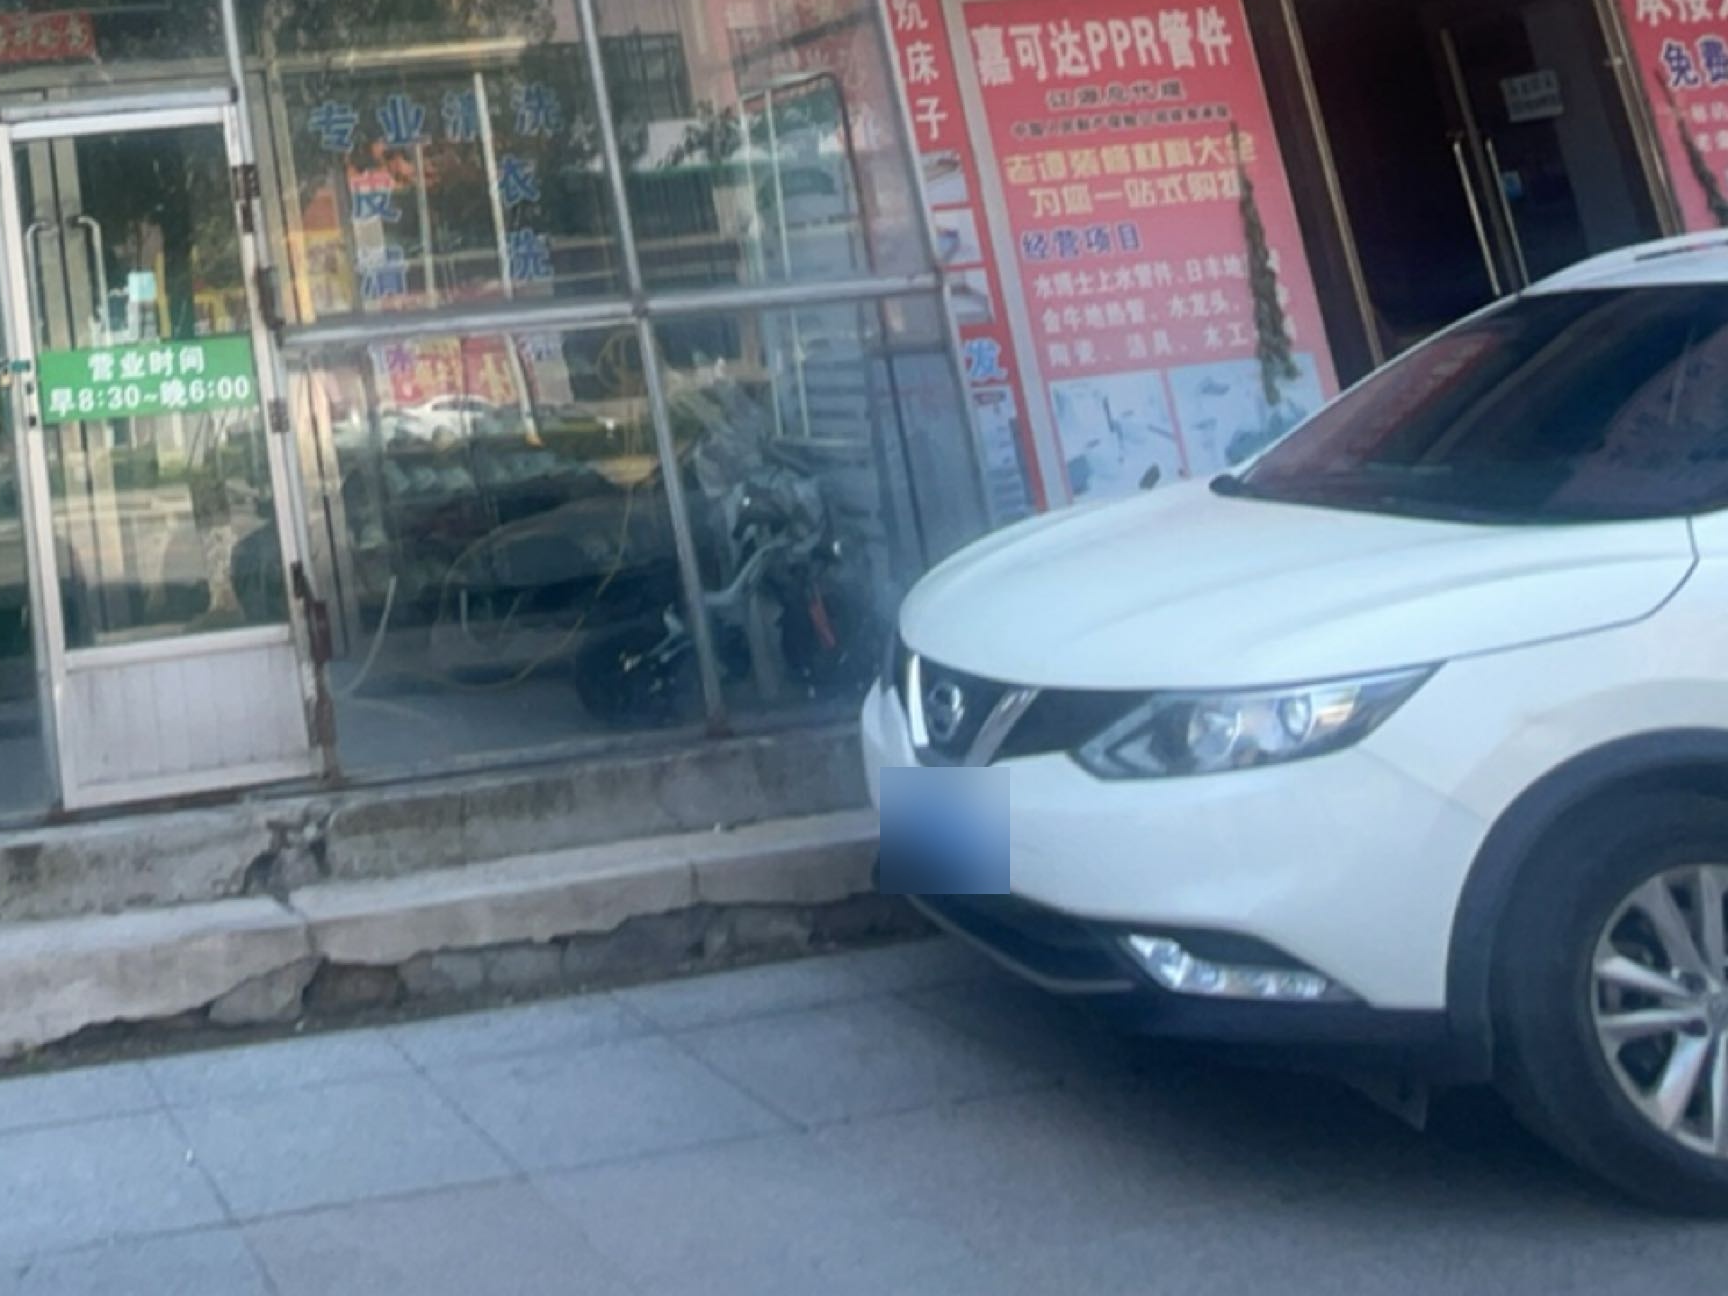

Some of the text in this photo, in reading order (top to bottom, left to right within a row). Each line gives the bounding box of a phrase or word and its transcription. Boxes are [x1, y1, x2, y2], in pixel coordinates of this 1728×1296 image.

[1021, 222, 1140, 260] 经营项目
[88, 345, 205, 383] 营业时间
